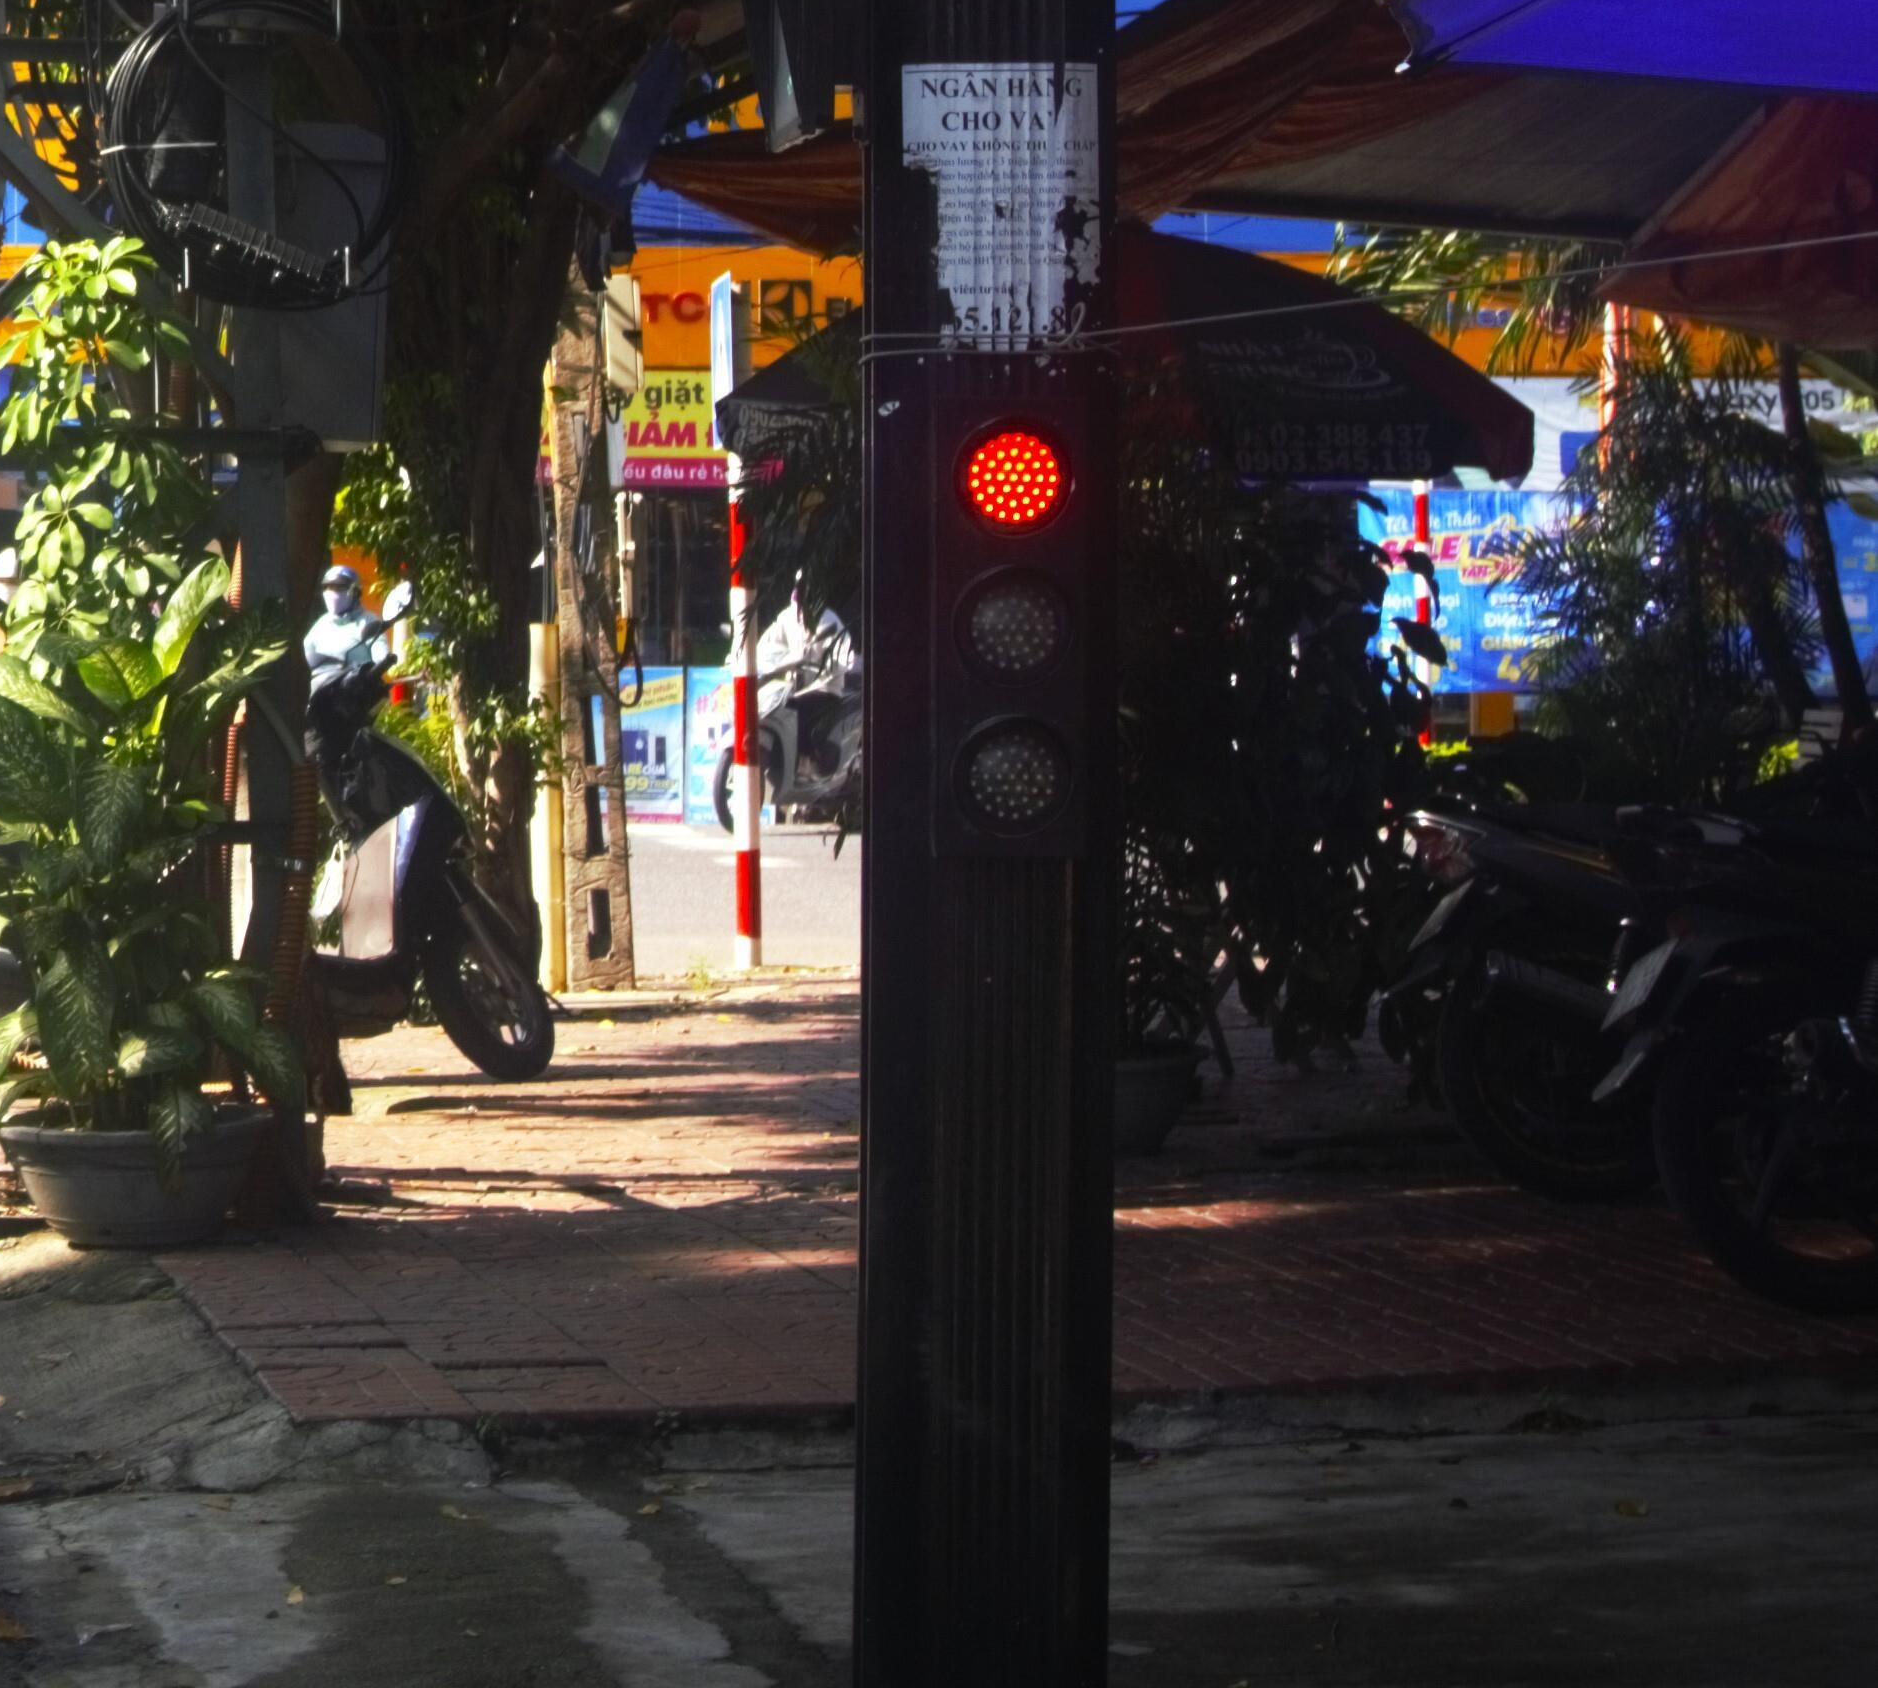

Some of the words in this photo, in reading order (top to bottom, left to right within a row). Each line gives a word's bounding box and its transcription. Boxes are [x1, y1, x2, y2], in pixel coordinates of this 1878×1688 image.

[921, 72, 998, 99] NGÂN
[942, 111, 1001, 131] CHO
[1010, 111, 1055, 131] VA
[940, 141, 967, 152] VAY
[644, 377, 705, 411] giặt
